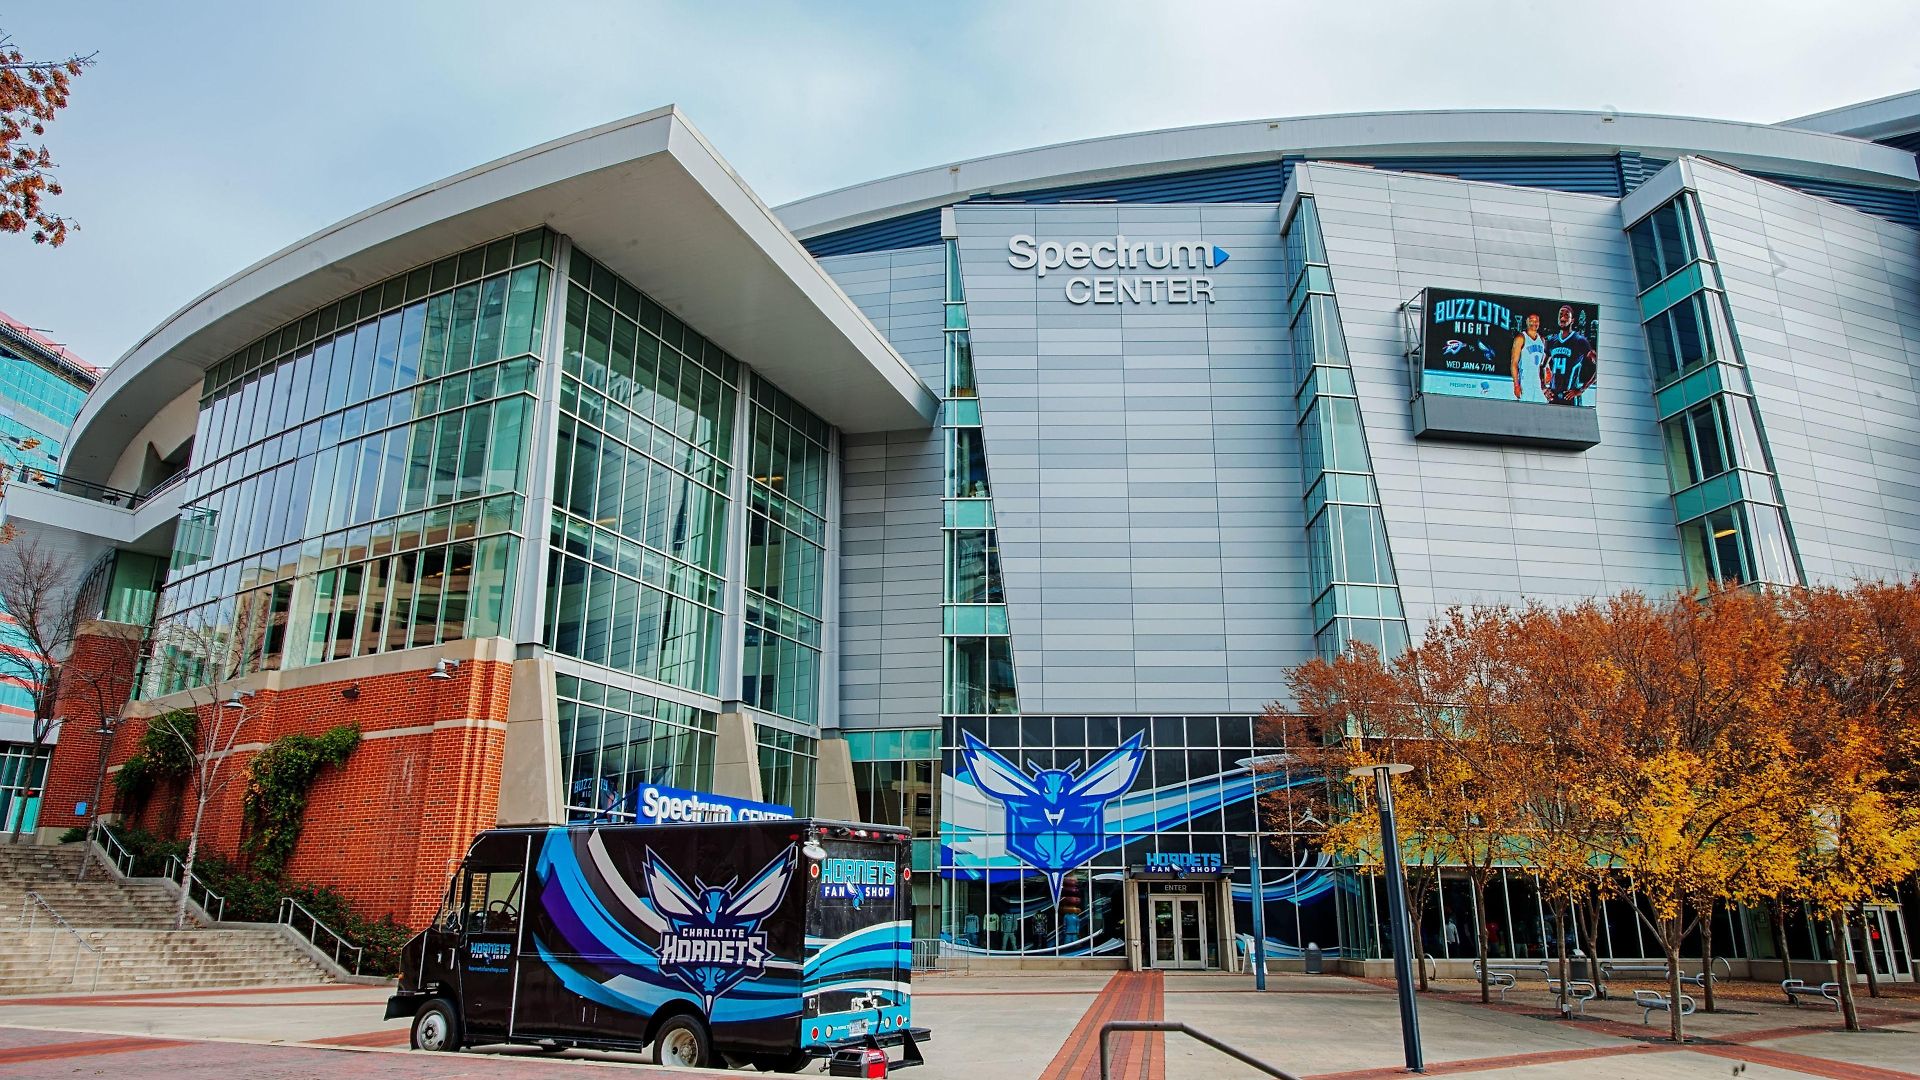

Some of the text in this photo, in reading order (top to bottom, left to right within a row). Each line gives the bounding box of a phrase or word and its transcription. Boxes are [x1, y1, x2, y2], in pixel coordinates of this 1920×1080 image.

[1008, 234, 1213, 277] Spectrum
[1065, 276, 1215, 304] CENTER
[1434, 298, 1511, 331] BUZZ CITY
[1454, 320, 1491, 336] NIGHT
[1446, 360, 1461, 369] WED
[1481, 363, 1496, 372] 7PM
[643, 787, 732, 824] Spectrum
[1146, 852, 1221, 867] HORNETS
[821, 858, 896, 885] HORNETS
[824, 886, 890, 897] FAN SHOP
[682, 928, 745, 938] CHARLOTTE
[470, 942, 511, 955] HORNETS
[661, 935, 765, 968] HORNETS
